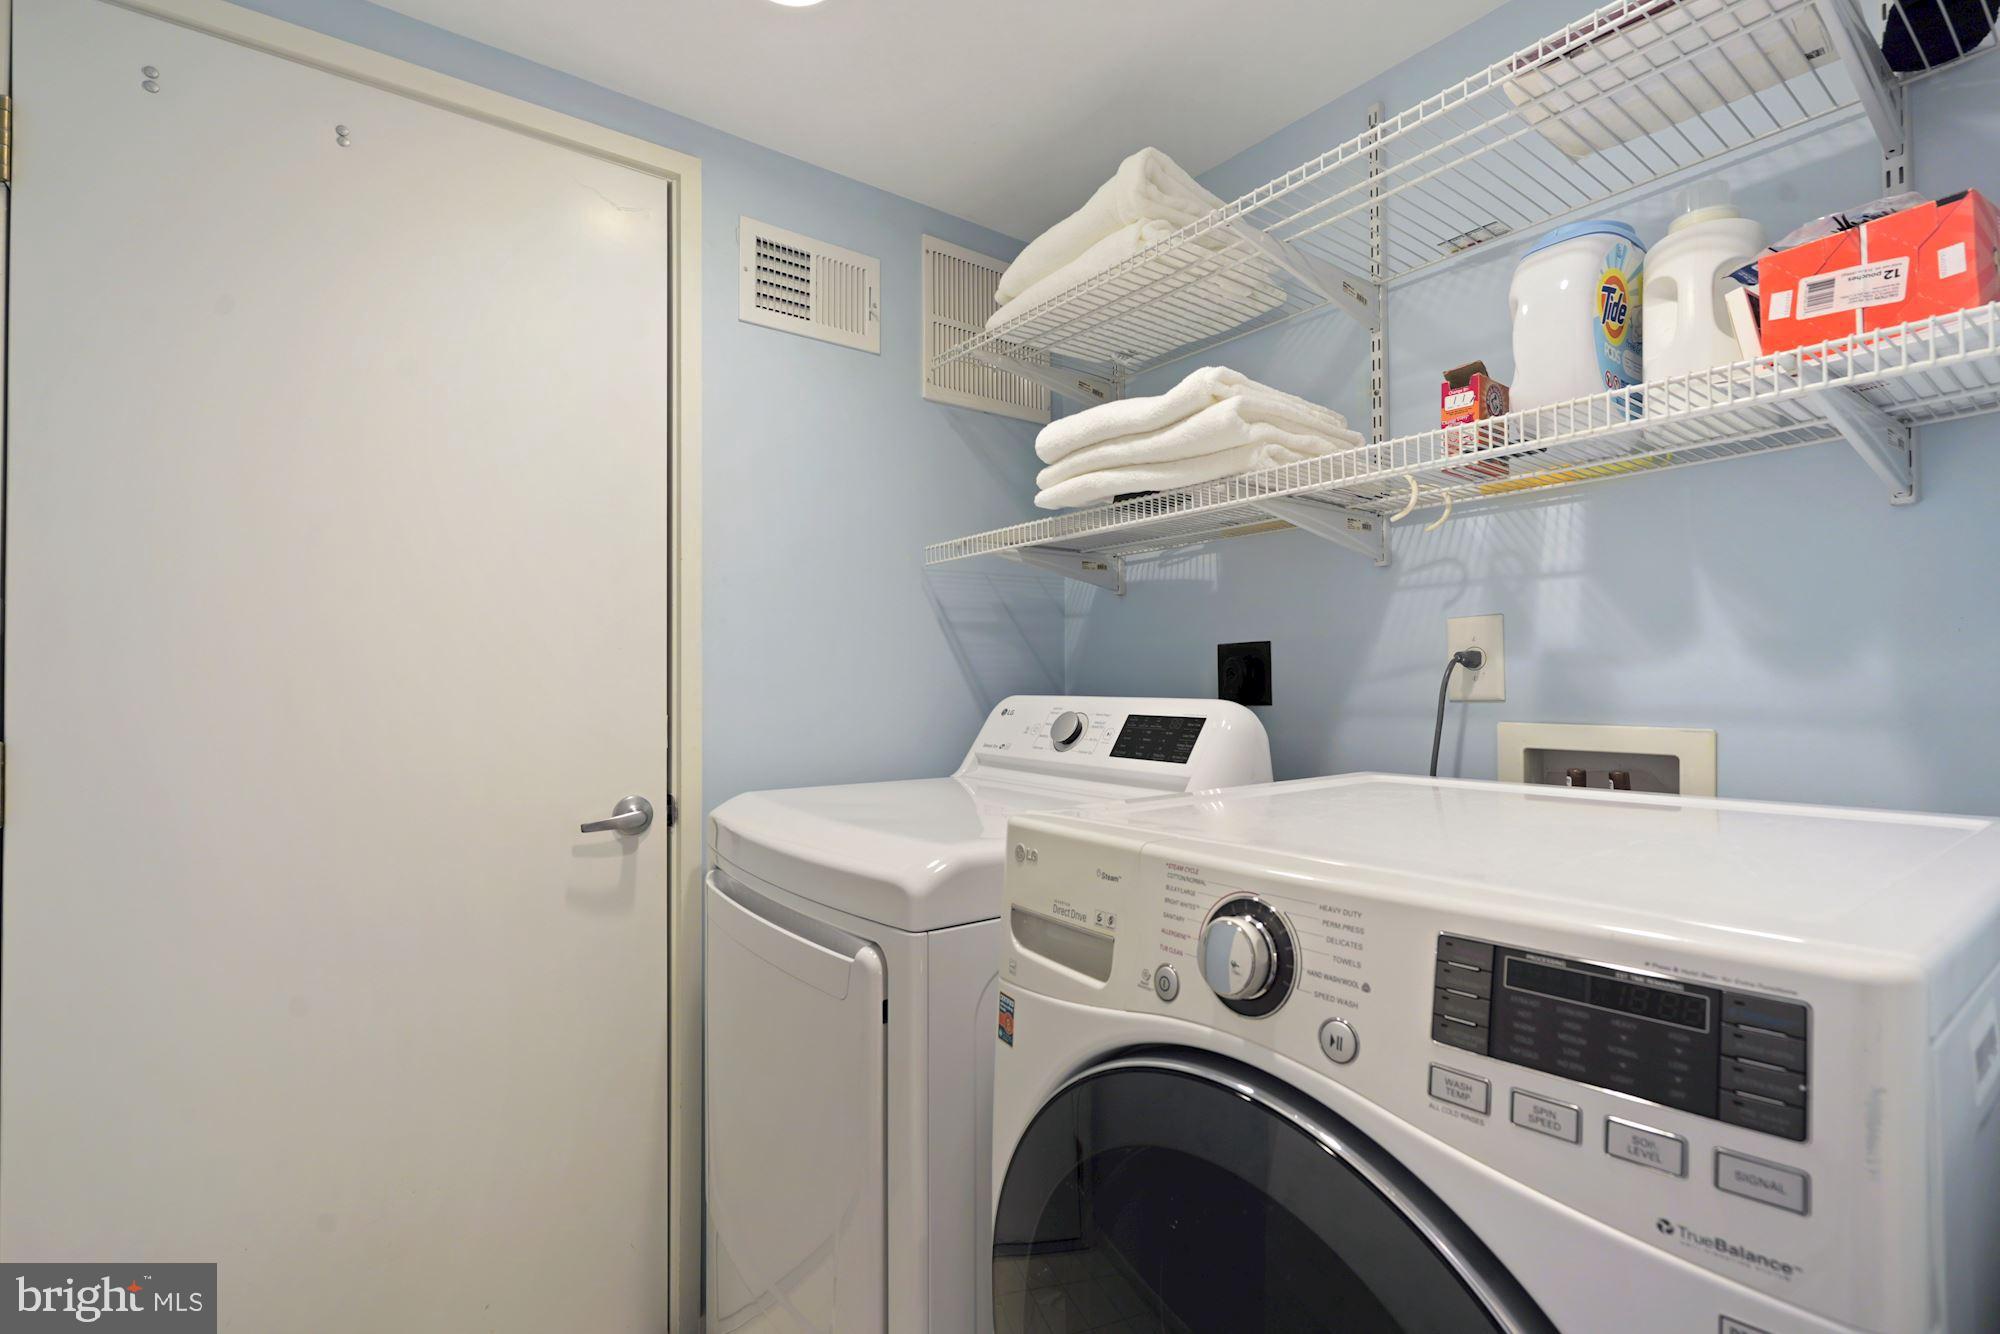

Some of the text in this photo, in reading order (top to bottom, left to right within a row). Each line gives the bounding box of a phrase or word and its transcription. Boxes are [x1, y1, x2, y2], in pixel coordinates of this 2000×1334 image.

[1848, 271, 1882, 281] pouches
[1884, 268, 1901, 280] 12
[1601, 285, 1627, 325] Tide
[1184, 866, 1200, 875] CYCLE
[1052, 903, 1070, 918] Direct
[1071, 908, 1087, 923] Drive
[1319, 904, 1362, 918] HEAVY DUTY
[1342, 924, 1365, 935] PRESS
[1326, 935, 1363, 951] DELICATES
[1332, 955, 1361, 969] TOWELS
[1313, 990, 1359, 1009] SPEED WASH
[1444, 1078, 1473, 1093] WASH
[1445, 1087, 1471, 1101] TEMP
[1428, 1102, 1441, 1112] ALL
[1441, 1105, 1459, 1118] COLD
[1532, 1105, 1557, 1120] SPIN
[1528, 1113, 1562, 1132] SPEED
[1631, 1135, 1656, 1149] SOIL
[1627, 1145, 1662, 1164] LEVEL
[1734, 1170, 1786, 1195] SIGNAL
